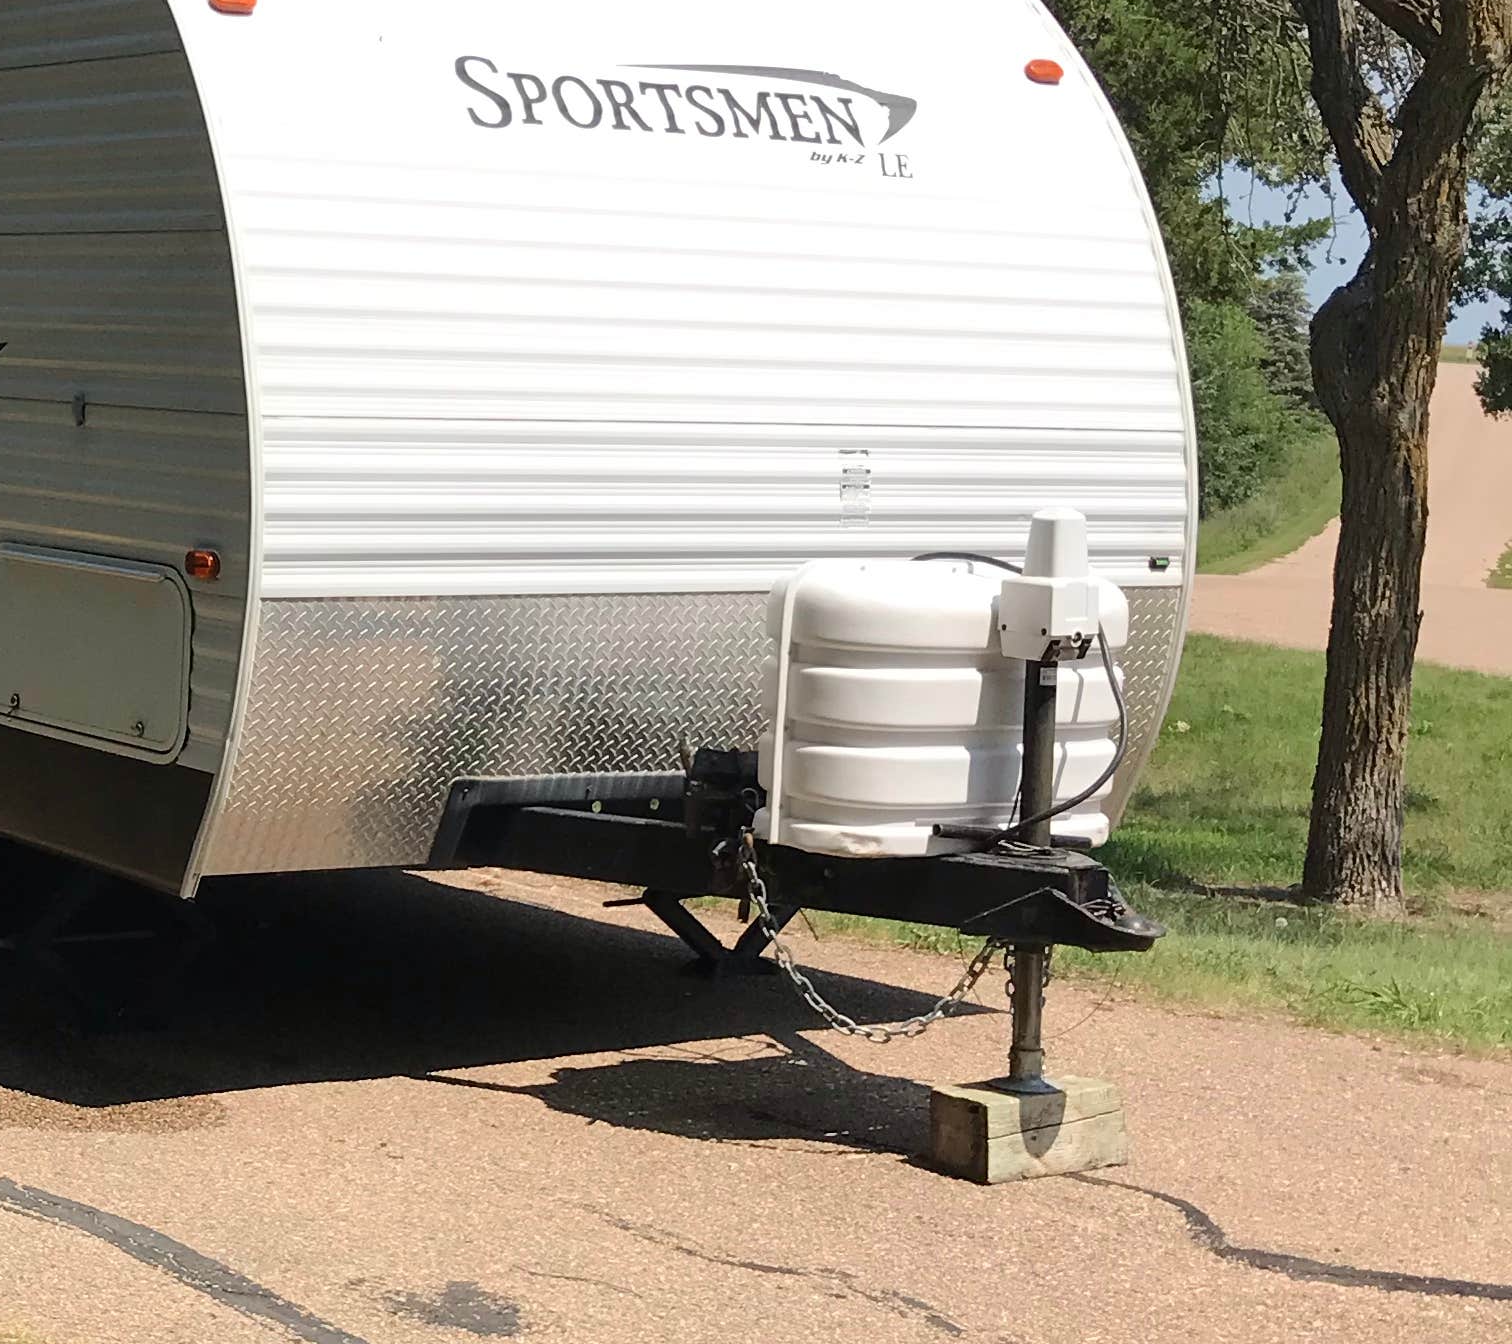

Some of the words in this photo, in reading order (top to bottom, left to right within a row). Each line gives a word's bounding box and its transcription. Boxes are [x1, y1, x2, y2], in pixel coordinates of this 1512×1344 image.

[454, 55, 866, 148] SPORTSMEN
[809, 151, 833, 165] by
[836, 152, 866, 165] K-Z
[877, 152, 914, 179] LE
